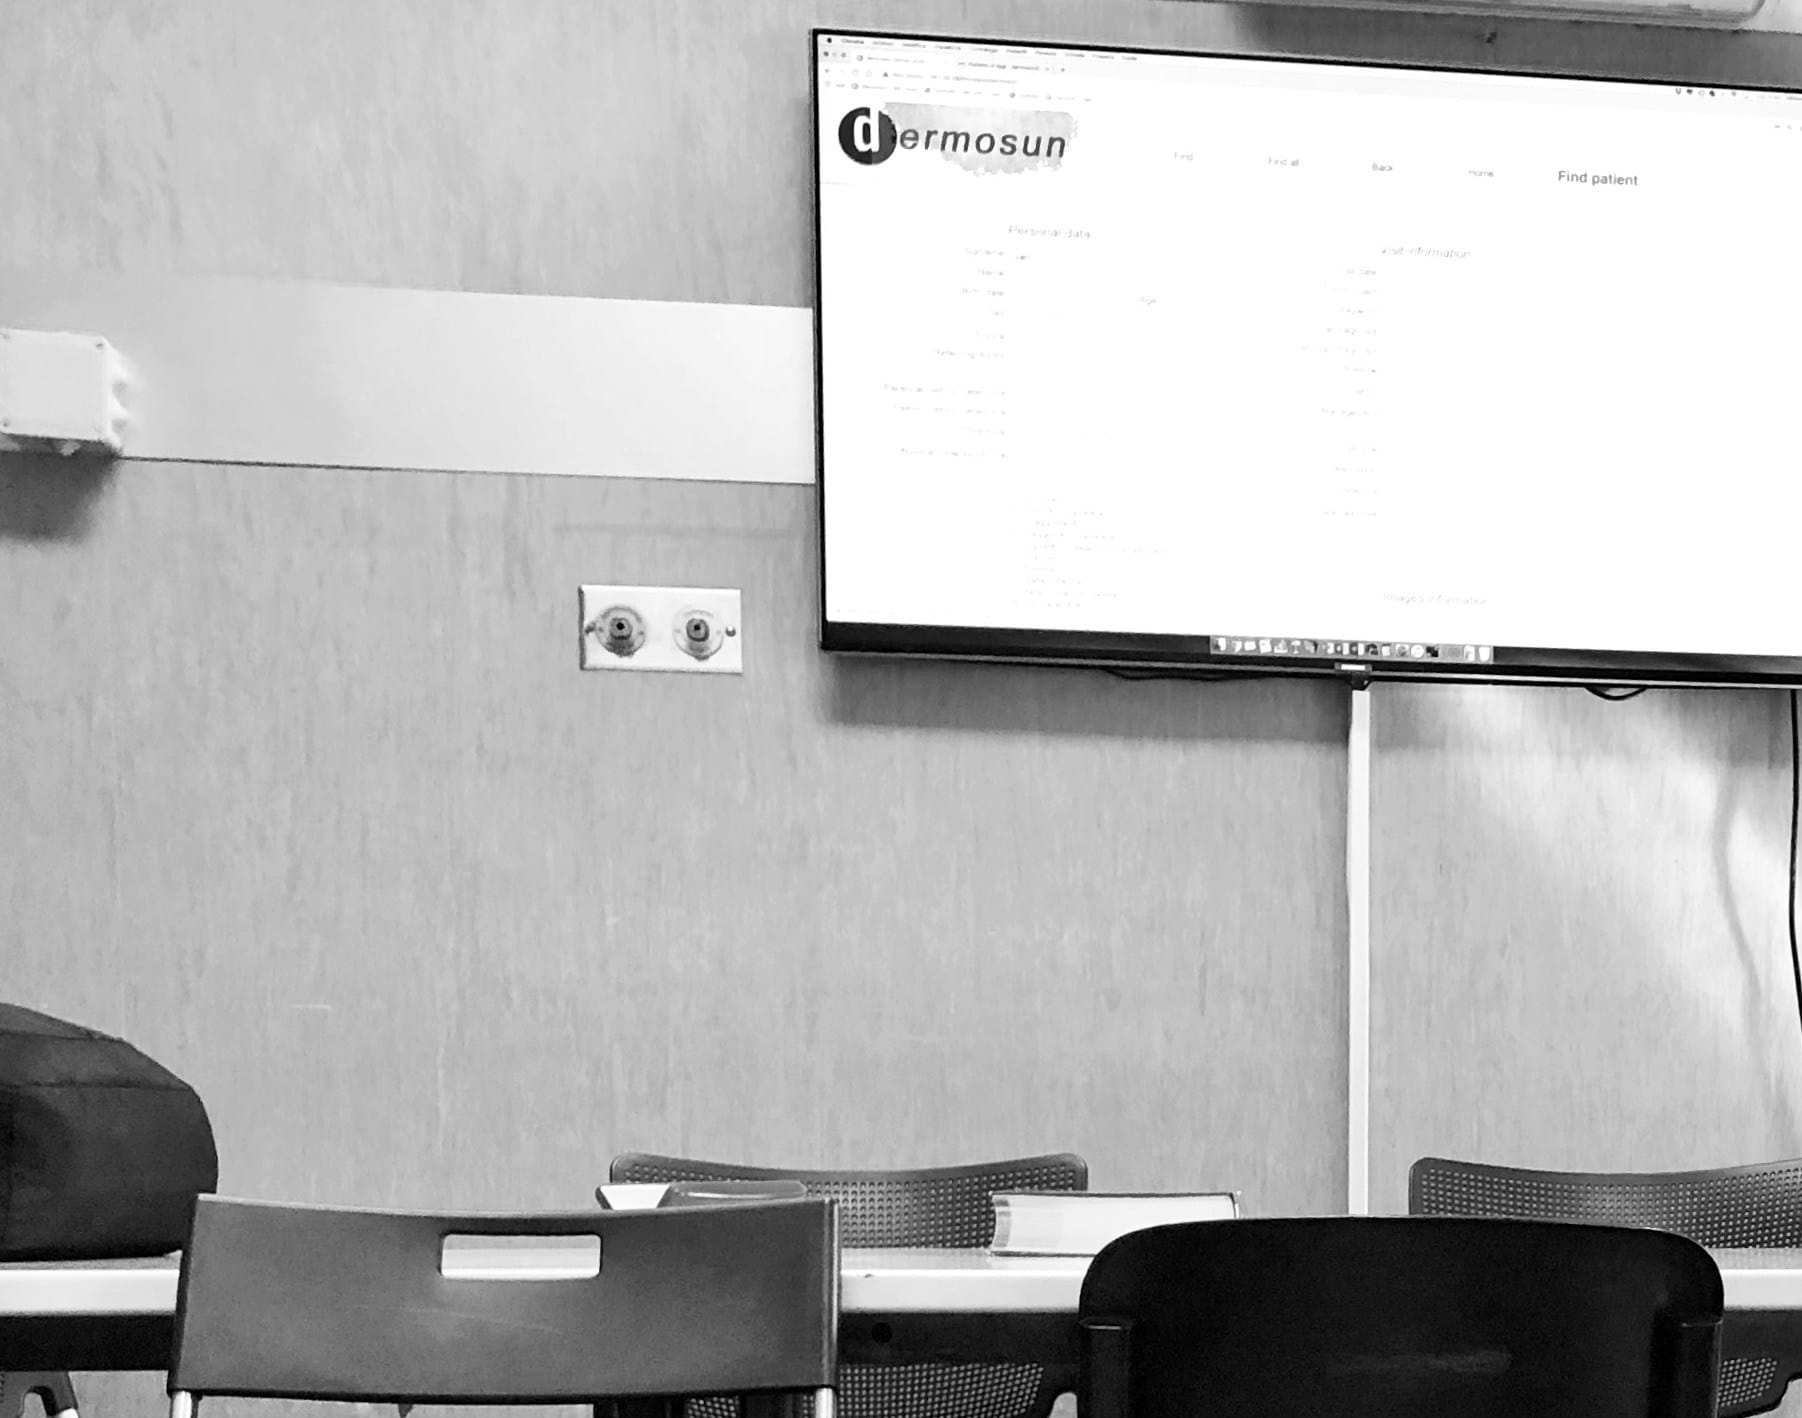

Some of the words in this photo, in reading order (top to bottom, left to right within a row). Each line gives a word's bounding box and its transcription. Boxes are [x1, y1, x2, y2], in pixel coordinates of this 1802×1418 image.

[851, 107, 1067, 159] dermosun
[1558, 170, 1588, 184] Find
[1592, 173, 1638, 187] patient
